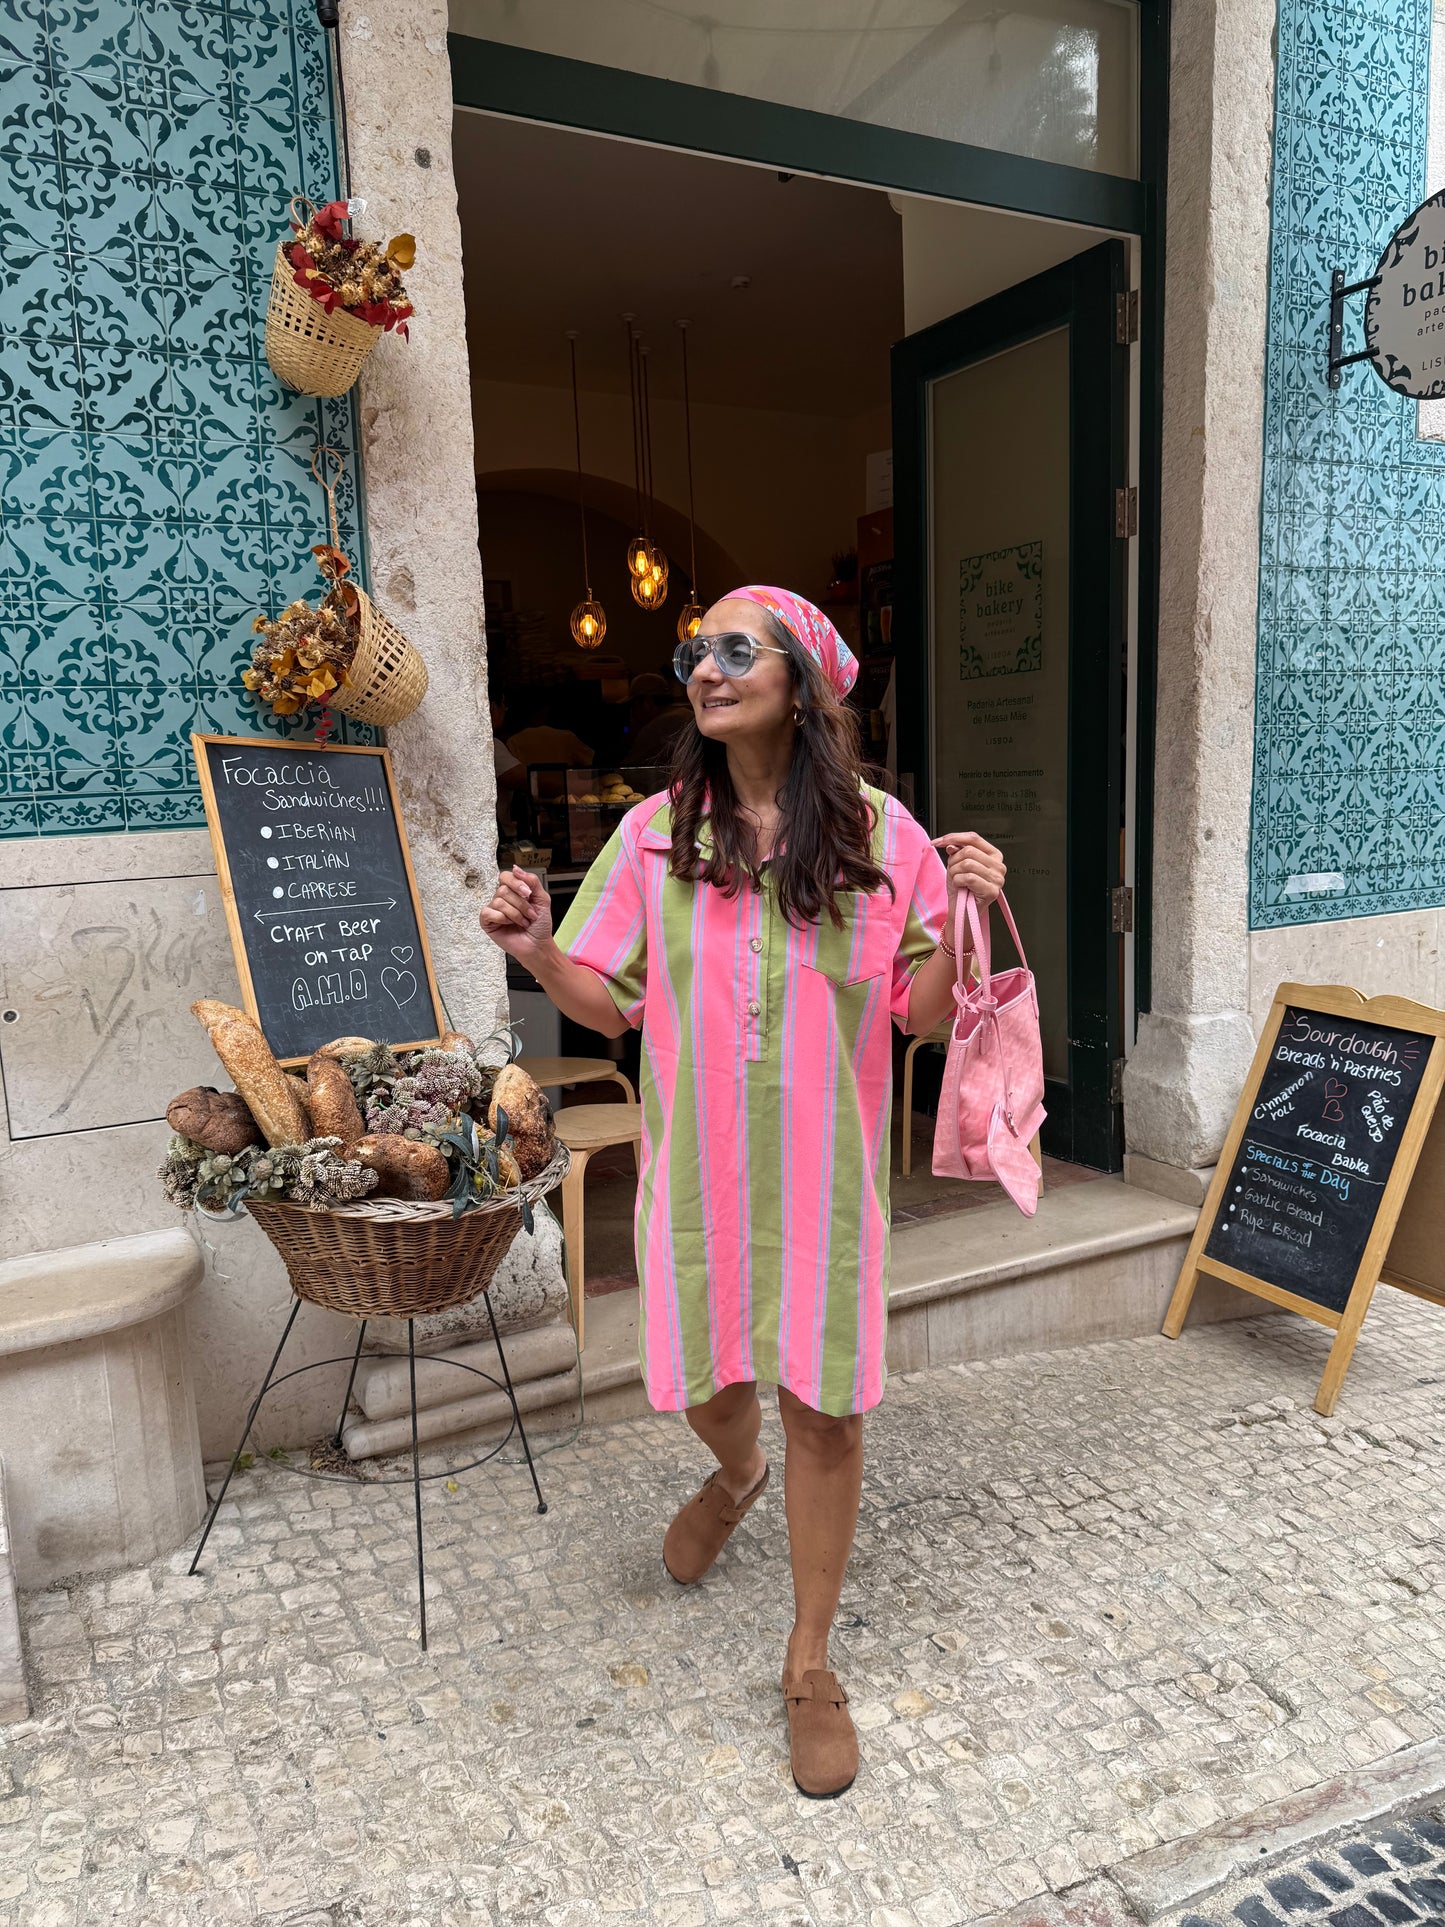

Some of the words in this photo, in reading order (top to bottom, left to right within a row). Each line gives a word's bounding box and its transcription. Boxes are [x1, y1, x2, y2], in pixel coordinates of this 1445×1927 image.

[1422, 355, 1445, 371] LIS
[985, 579, 1014, 598] bike
[976, 598, 1024, 618] bakery
[222, 757, 340, 789] Focaccia
[983, 769, 992, 778] de
[993, 768, 1045, 779] funcionamento
[1028, 867, 1050, 877] TEMPO
[287, 881, 357, 899] CAPRESE
[338, 918, 381, 937] Beer
[1276, 1046, 1326, 1070] Breads
[1343, 1060, 1402, 1087] Pastries
[1254, 1070, 1314, 1120] Cinnamon
[1382, 1114, 1395, 1131] de
[1296, 1123, 1347, 1150] Focaccia
[1331, 1153, 1370, 1176] Babka
[1251, 1168, 1318, 1203] Sandwiches
[1319, 1169, 1350, 1201] Day
[1240, 1208, 1265, 1234] Rye
[1286, 1202, 1323, 1227] Bread
